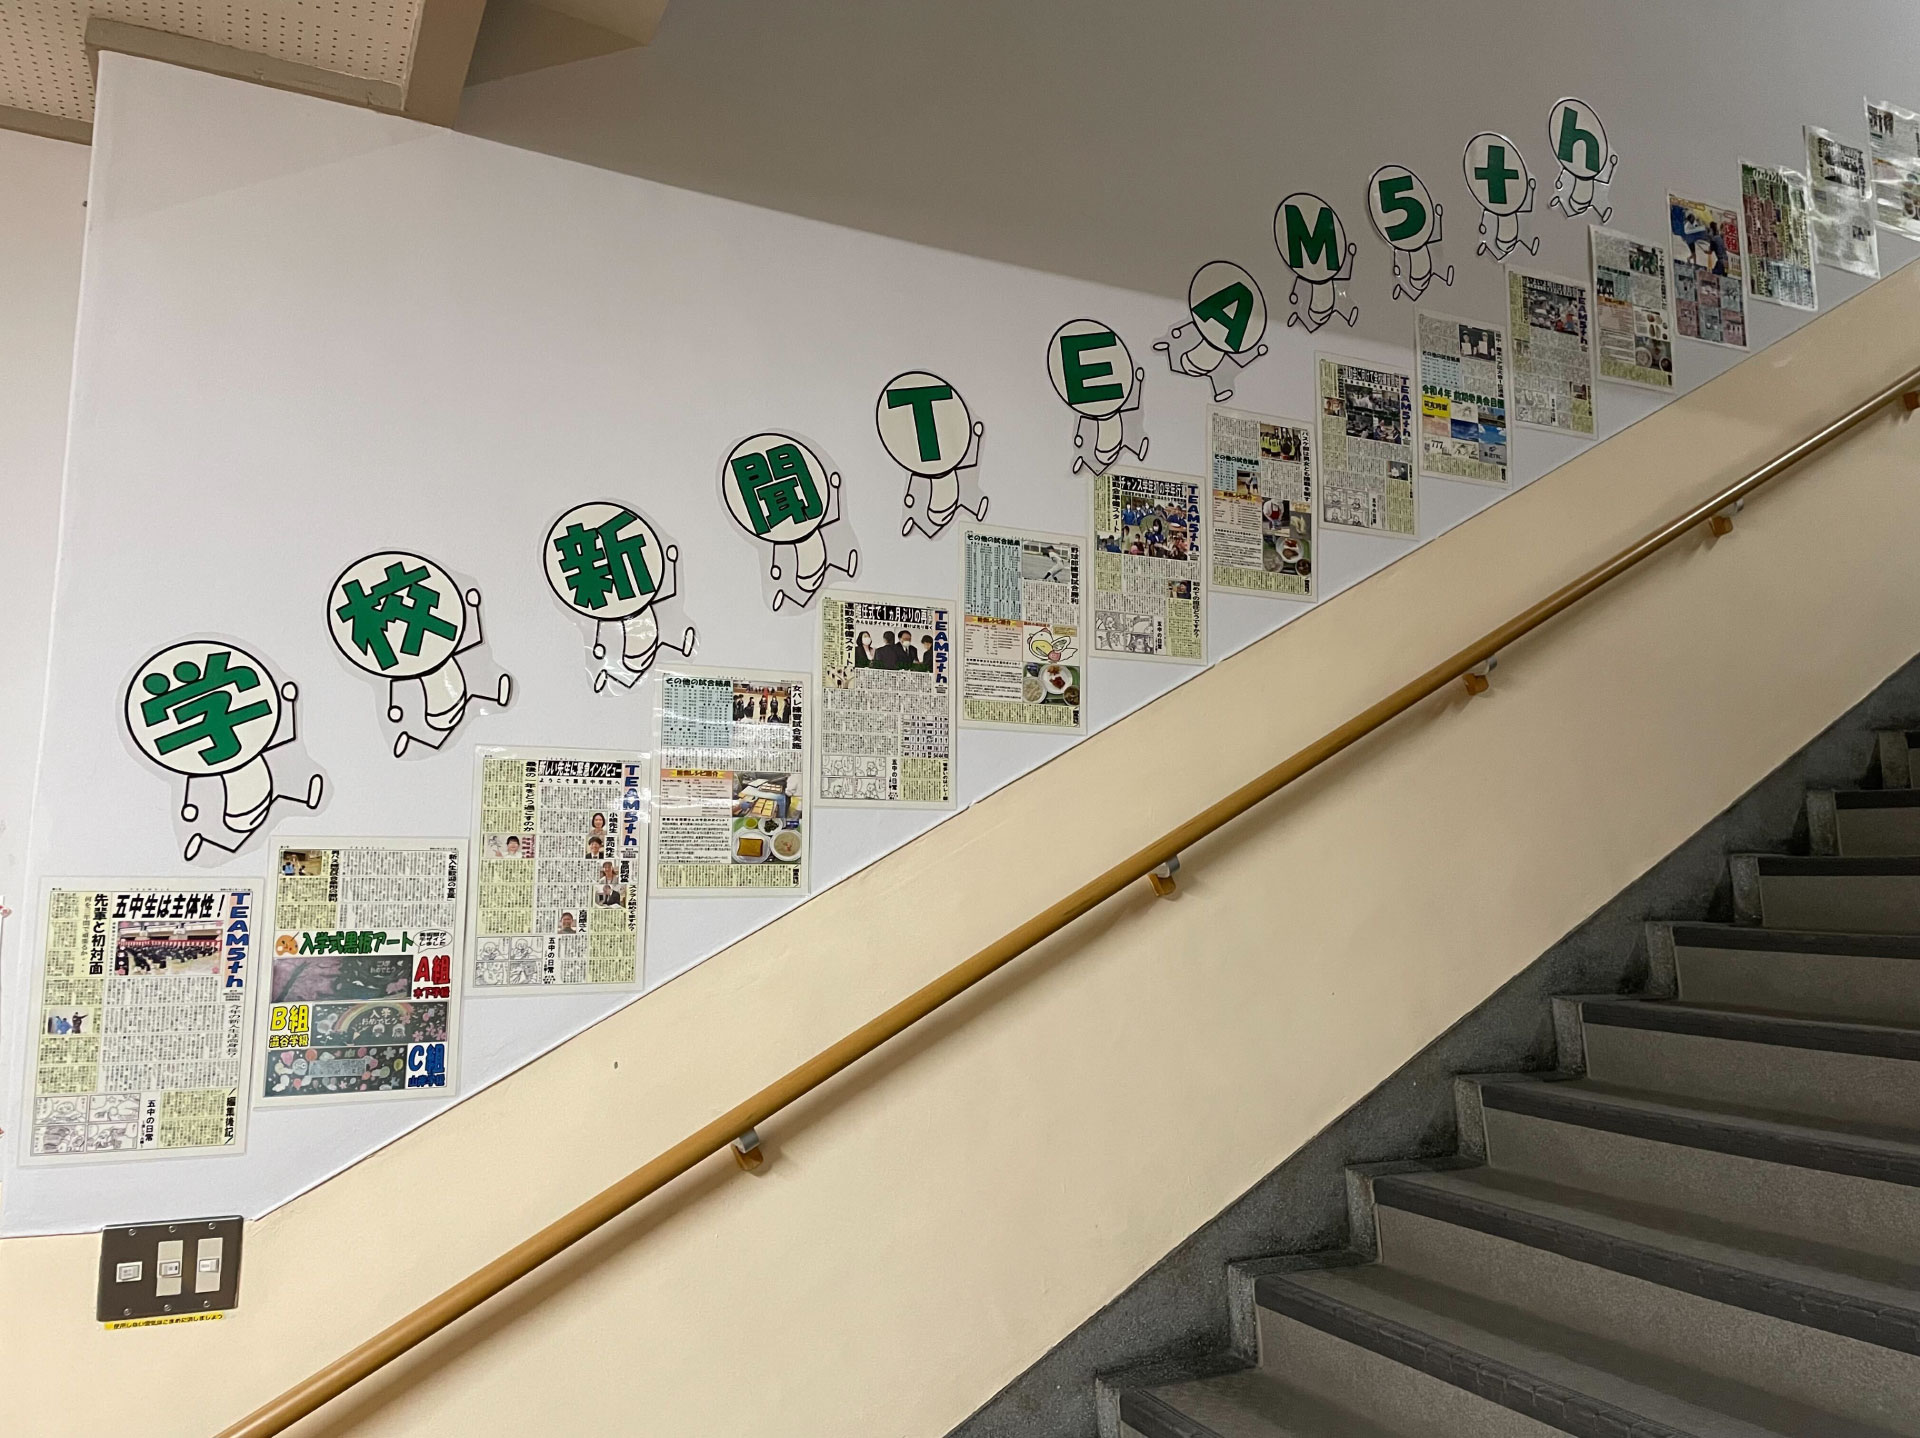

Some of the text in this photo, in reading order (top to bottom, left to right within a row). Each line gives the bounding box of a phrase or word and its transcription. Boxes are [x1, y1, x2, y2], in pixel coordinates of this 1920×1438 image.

[886, 384, 953, 463] T
[1060, 330, 1125, 405] E
[1192, 282, 1254, 352] A
[1284, 204, 1341, 272] M
[1378, 174, 1427, 242] 5
[1558, 106, 1601, 172] h
[1400, 376, 1412, 437] TEAM5th
[1187, 485, 1200, 552] TEAM5th
[140, 443, 824, 766] 学 校 新 聞
[934, 609, 949, 684] TEAM5th
[622, 764, 641, 846] TEAM5th
[89, 893, 109, 975] 先輩と初対面
[112, 893, 226, 919] 五中生は主体性！
[224, 891, 251, 988] TEAM5th
[299, 931, 414, 955] 入学式黒板アート
[414, 954, 451, 985] A組
[270, 1004, 310, 1033] B組
[408, 1043, 446, 1074] C組
[145, 1099, 156, 1142] 五中の日常
